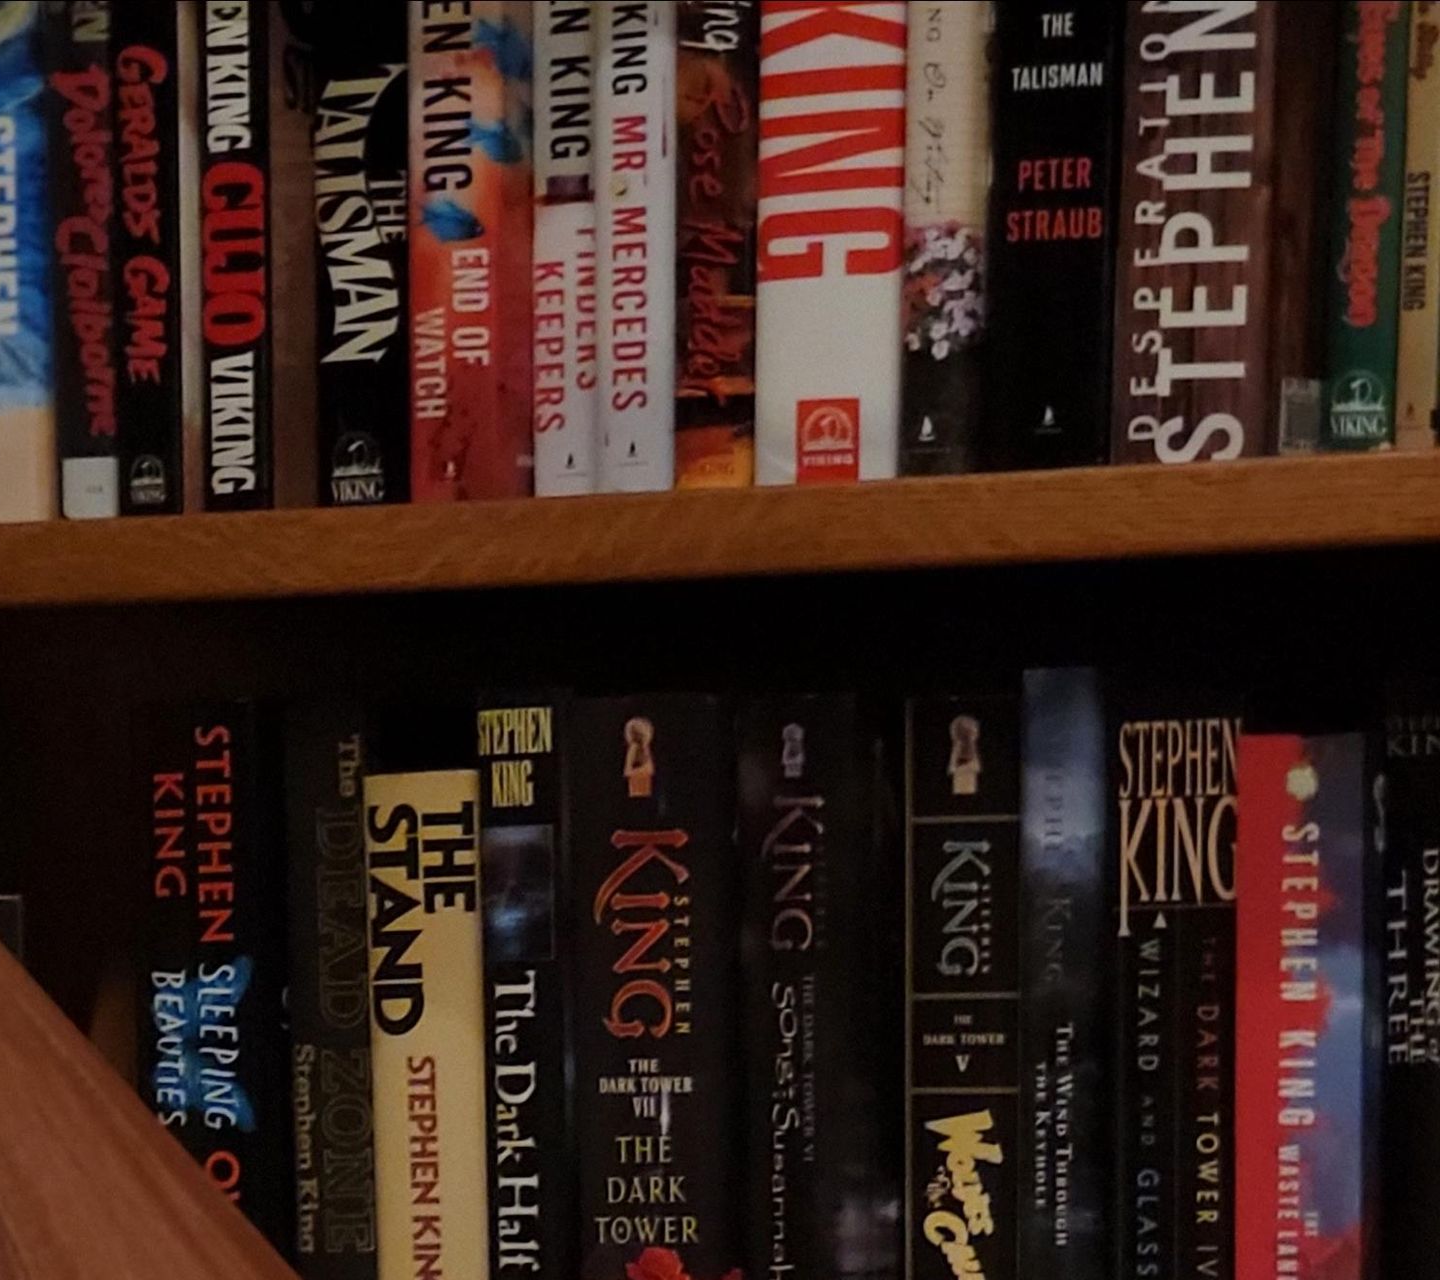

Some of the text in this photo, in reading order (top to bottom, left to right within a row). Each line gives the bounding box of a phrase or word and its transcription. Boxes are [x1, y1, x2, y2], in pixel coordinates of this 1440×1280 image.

[1011, 62, 1104, 93] TALISMAN
[1041, 13, 1074, 39] THE
[206, 64, 252, 153] KING
[422, 77, 473, 192] KING
[549, 56, 592, 160] KING
[757, 0, 905, 284] KING
[314, 64, 408, 364] TALISMAN
[369, 170, 408, 243] THE
[611, 2, 648, 411] KING MERCEDES
[1006, 207, 1103, 243] STRAUB
[1018, 156, 1092, 192] PETER
[1155, 0, 1258, 465] STEPHEN
[201, 162, 266, 346] CUJO
[1402, 169, 1431, 312] STEPHEN KING
[56, 216, 118, 437] Claiborne
[122, 255, 171, 384] GAME
[414, 307, 447, 420] WATCH
[452, 248, 491, 367] END OF
[534, 261, 565, 433] KEEPERS
[209, 351, 256, 495] VIKING
[802, 451, 854, 468] VIKING
[1331, 414, 1387, 438] VIKING
[478, 706, 554, 757] STEPHEN
[490, 760, 536, 808] KING
[1118, 718, 1242, 798] STEPHEN
[153, 772, 187, 898] KING
[194, 726, 234, 944] STEPHEN
[417, 800, 478, 914] THE
[760, 796, 825, 952] KING
[1117, 796, 1238, 937] KING
[365, 804, 427, 1037] STAND
[594, 828, 691, 1039] KING
[673, 895, 693, 1036] STEPHEN
[1277, 822, 1320, 1128] STEPHEN KING
[1387, 868, 1411, 1066] THREE
[197, 962, 240, 1131] SLEEPING
[598, 1075, 693, 1094] DARK TOWER
[628, 1058, 660, 1074] THE
[632, 1098, 657, 1119] VII
[1133, 937, 1160, 1278] WIZARD GLASS
[405, 1056, 438, 1206] STEPHEN
[493, 969, 541, 1273] The Dark Half
[615, 1135, 673, 1164] THE
[1194, 1002, 1221, 1226] DARK TOWER
[594, 1215, 700, 1245] TOWER
[606, 1176, 687, 1204] DARK
[1277, 1142, 1300, 1226] WASTE
